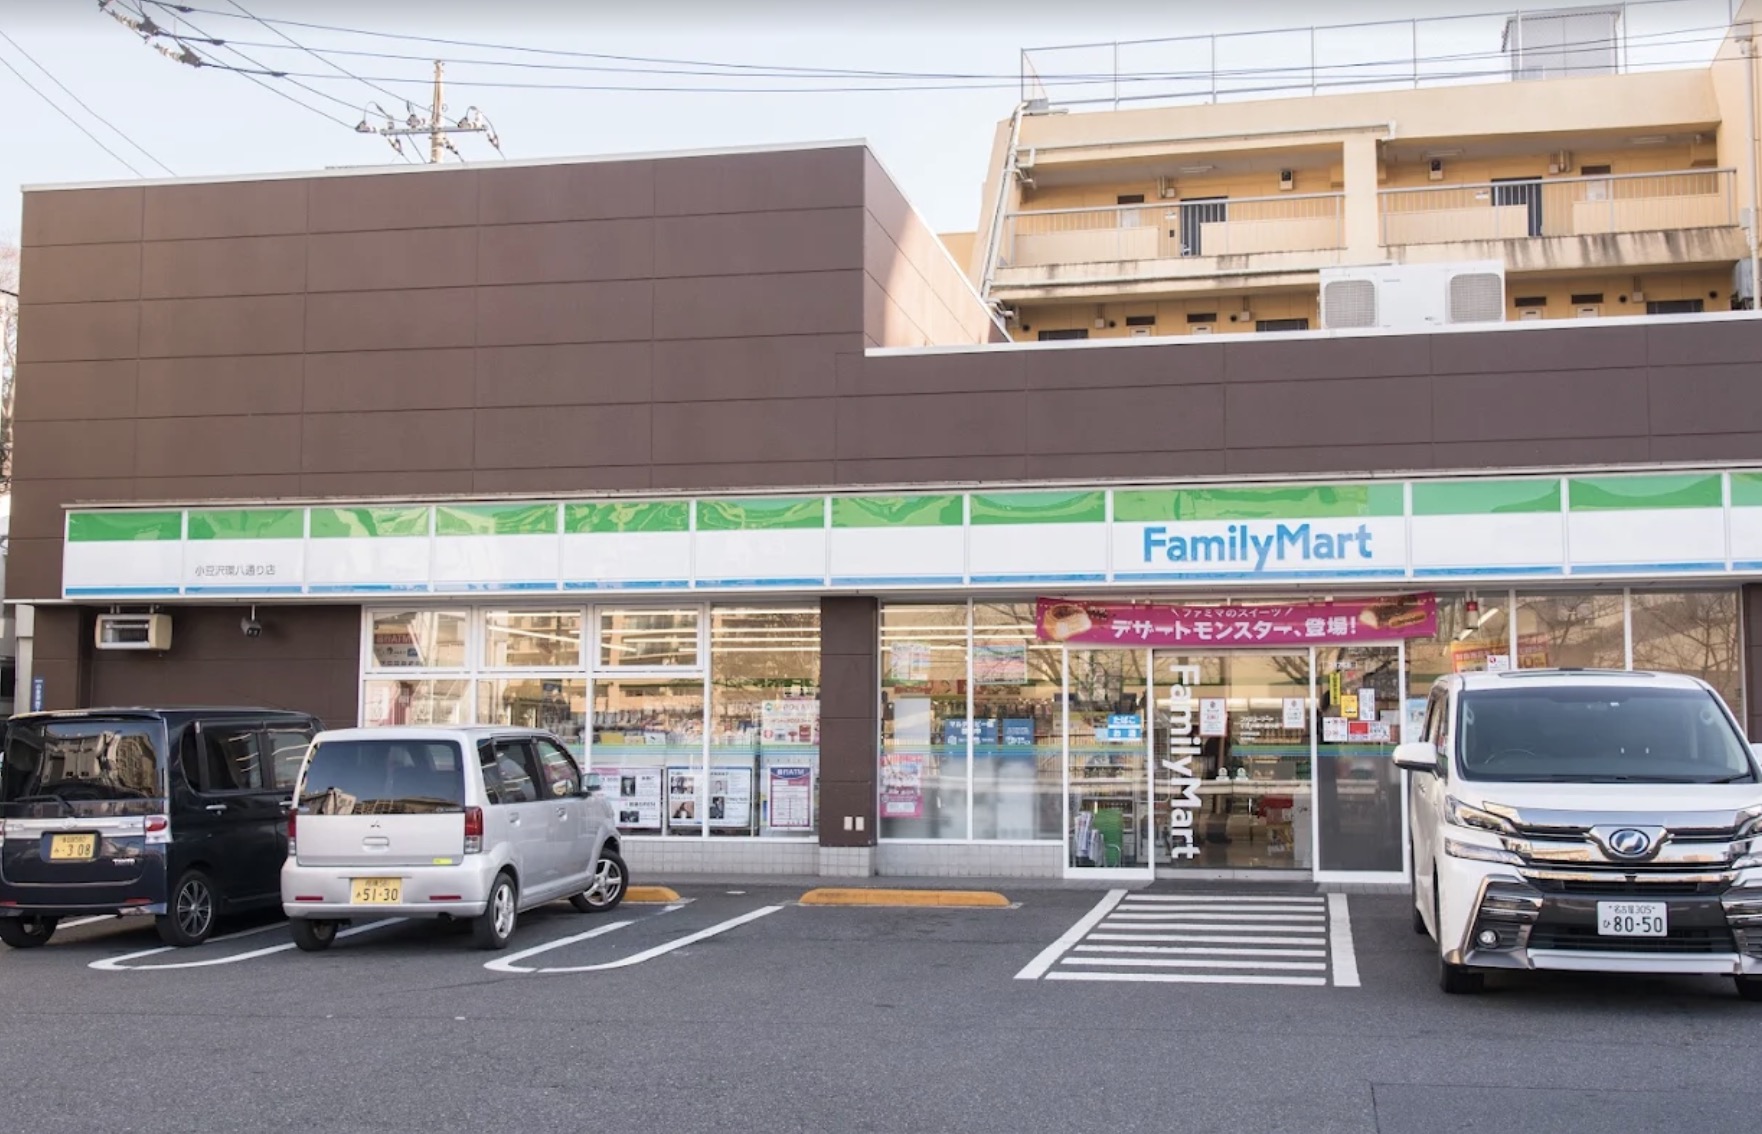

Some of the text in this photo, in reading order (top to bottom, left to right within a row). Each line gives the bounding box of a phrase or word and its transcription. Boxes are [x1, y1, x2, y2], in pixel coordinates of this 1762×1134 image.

[1143, 523, 1373, 572] FamilyMart
[1182, 607, 1281, 618] ファミマのスイーツ
[1111, 615, 1357, 640] デザートモンスター、登場!
[1162, 664, 1202, 860] FamilyMart
[363, 888, 398, 901] 51-30
[1614, 915, 1663, 932] 80-50
